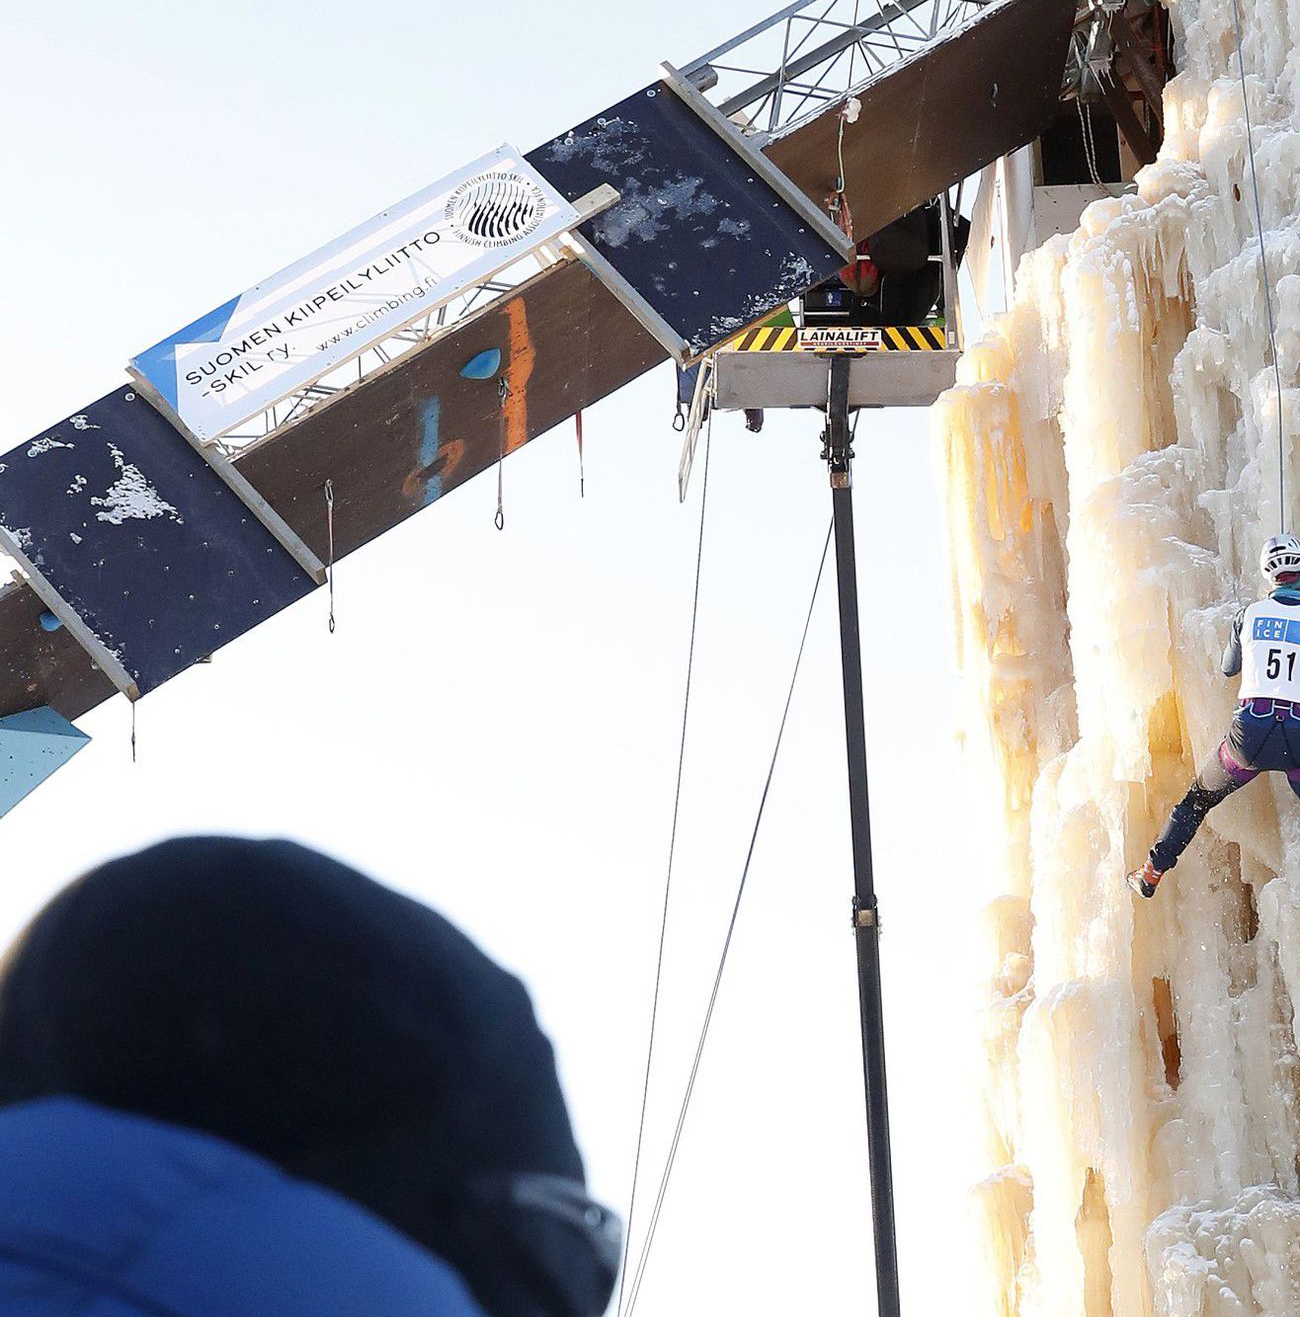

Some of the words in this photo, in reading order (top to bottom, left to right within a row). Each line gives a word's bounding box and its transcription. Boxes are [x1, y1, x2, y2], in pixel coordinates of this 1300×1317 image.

[444, 194, 458, 220] SUOMEN
[456, 172, 507, 198] KIIPEILYLIITTO
[509, 173, 524, 184] SKIL
[453, 229, 481, 246] FINNISH
[483, 233, 523, 248] CLIMBING
[523, 197, 547, 236] ASSOCIATION
[185, 322, 281, 385] SUOMEN
[284, 231, 441, 327] KIIPEILYLIITTO
[316, 275, 438, 352] www.climbing.fi
[800, 331, 879, 341] LAINALIFT
[201, 361, 263, 397] -SKIL
[1256, 629, 1281, 638] ICE
[1257, 619, 1283, 629] FIN
[1266, 648, 1296, 682] 51
